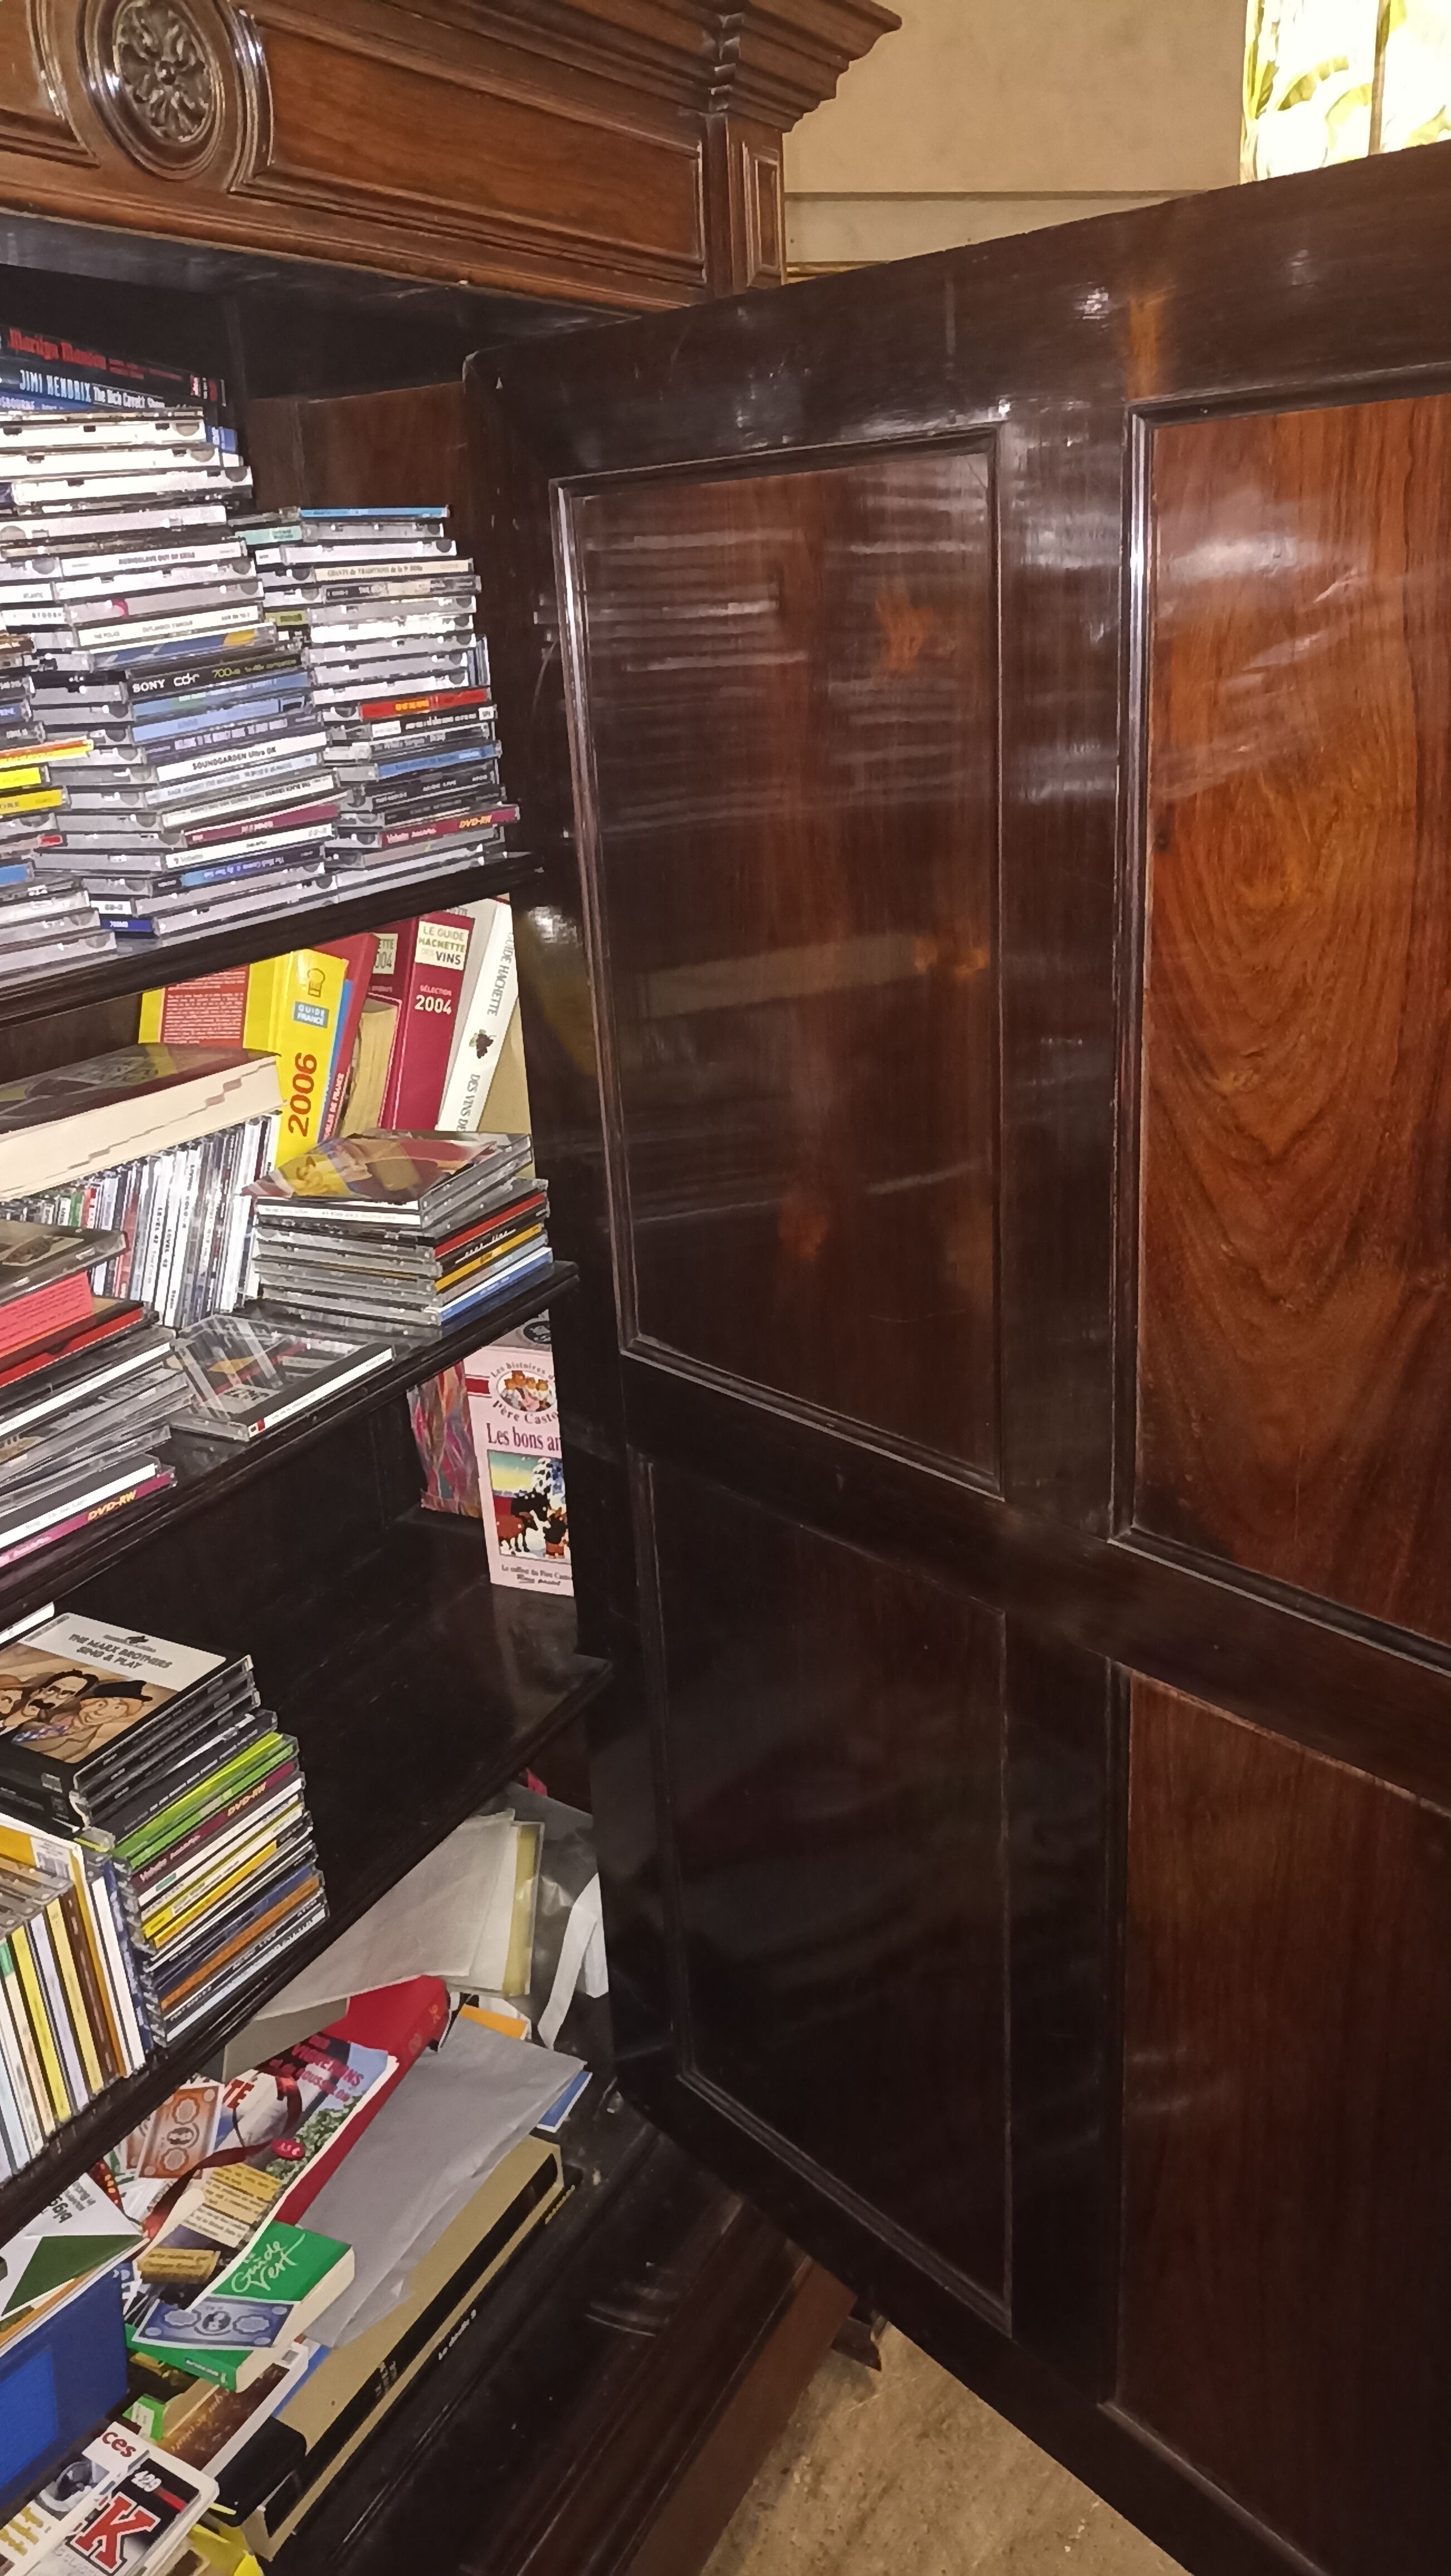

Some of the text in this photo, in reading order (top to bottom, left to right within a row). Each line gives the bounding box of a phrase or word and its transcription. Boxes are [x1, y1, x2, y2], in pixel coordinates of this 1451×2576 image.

[20, 369, 43, 393] JIMI
[46, 375, 91, 402] HENDRIX
[132, 679, 165, 693] SONY
[192, 752, 247, 770] SOUNDGARDEN
[423, 925, 465, 941] LE GUIDE
[418, 937, 465, 953] HACHETTE
[436, 950, 461, 965] VINS
[487, 932, 514, 1016] GUIDE HACHETTE
[298, 1004, 325, 1018] GUIDE
[415, 994, 452, 1014] 2004
[297, 1012, 324, 1026] FRANCE
[288, 1052, 317, 1137] 2006
[466, 1074, 480, 1093] DES
[460, 1095, 475, 1116] VINS
[154, 1207, 163, 1231] LEVEL
[153, 1234, 159, 1244] 42
[164, 1228, 172, 1253] LEVEL
[490, 1367, 505, 1378] Les
[506, 1362, 546, 1374] histoires
[493, 1400, 559, 1424] Père Casto
[486, 1423, 509, 1446] Les
[512, 1426, 544, 1450] bons
[87, 1489, 137, 1521] DVD-RW
[69, 1633, 89, 1644] THE
[87, 1640, 120, 1653] MARX
[118, 1648, 173, 1668] BROTHERS
[76, 1646, 105, 1658] SING
[113, 1656, 143, 1668] PLAY
[231, 2241, 289, 2293] Guide
[251, 2233, 306, 2291] Vert
[102, 2431, 137, 2458] ces
[131, 2470, 162, 2492] 429
[71, 2491, 161, 2574] K
